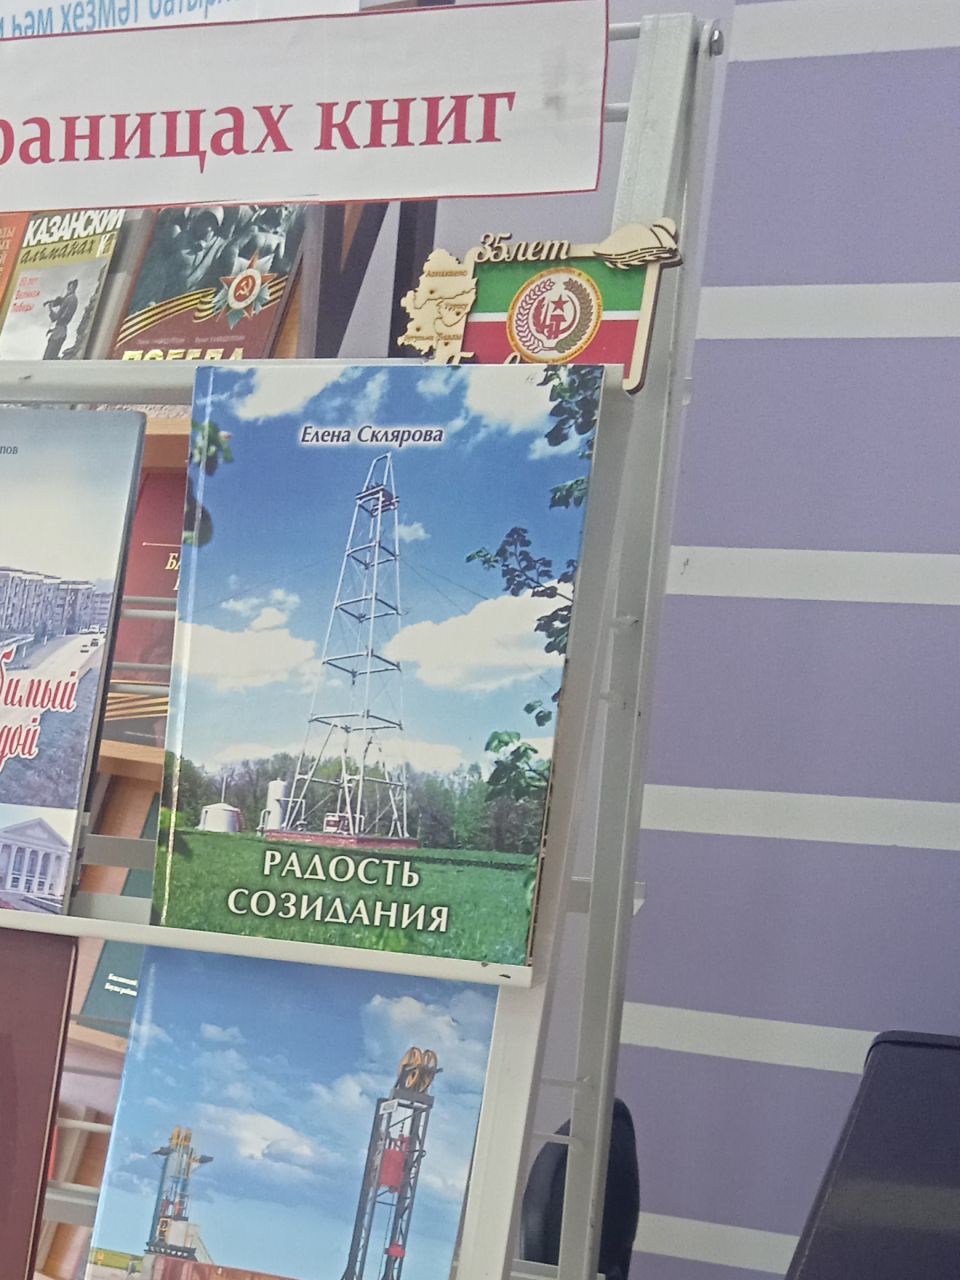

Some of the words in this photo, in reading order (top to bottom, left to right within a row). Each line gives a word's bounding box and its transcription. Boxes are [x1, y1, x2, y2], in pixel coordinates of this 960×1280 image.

[314, 91, 515, 150] книг
[301, 426, 351, 443] Елена
[357, 426, 444, 448] Склярова
[262, 849, 421, 887] РАДОСТЬ
[226, 887, 450, 934] СОЗИДАНИЯ
